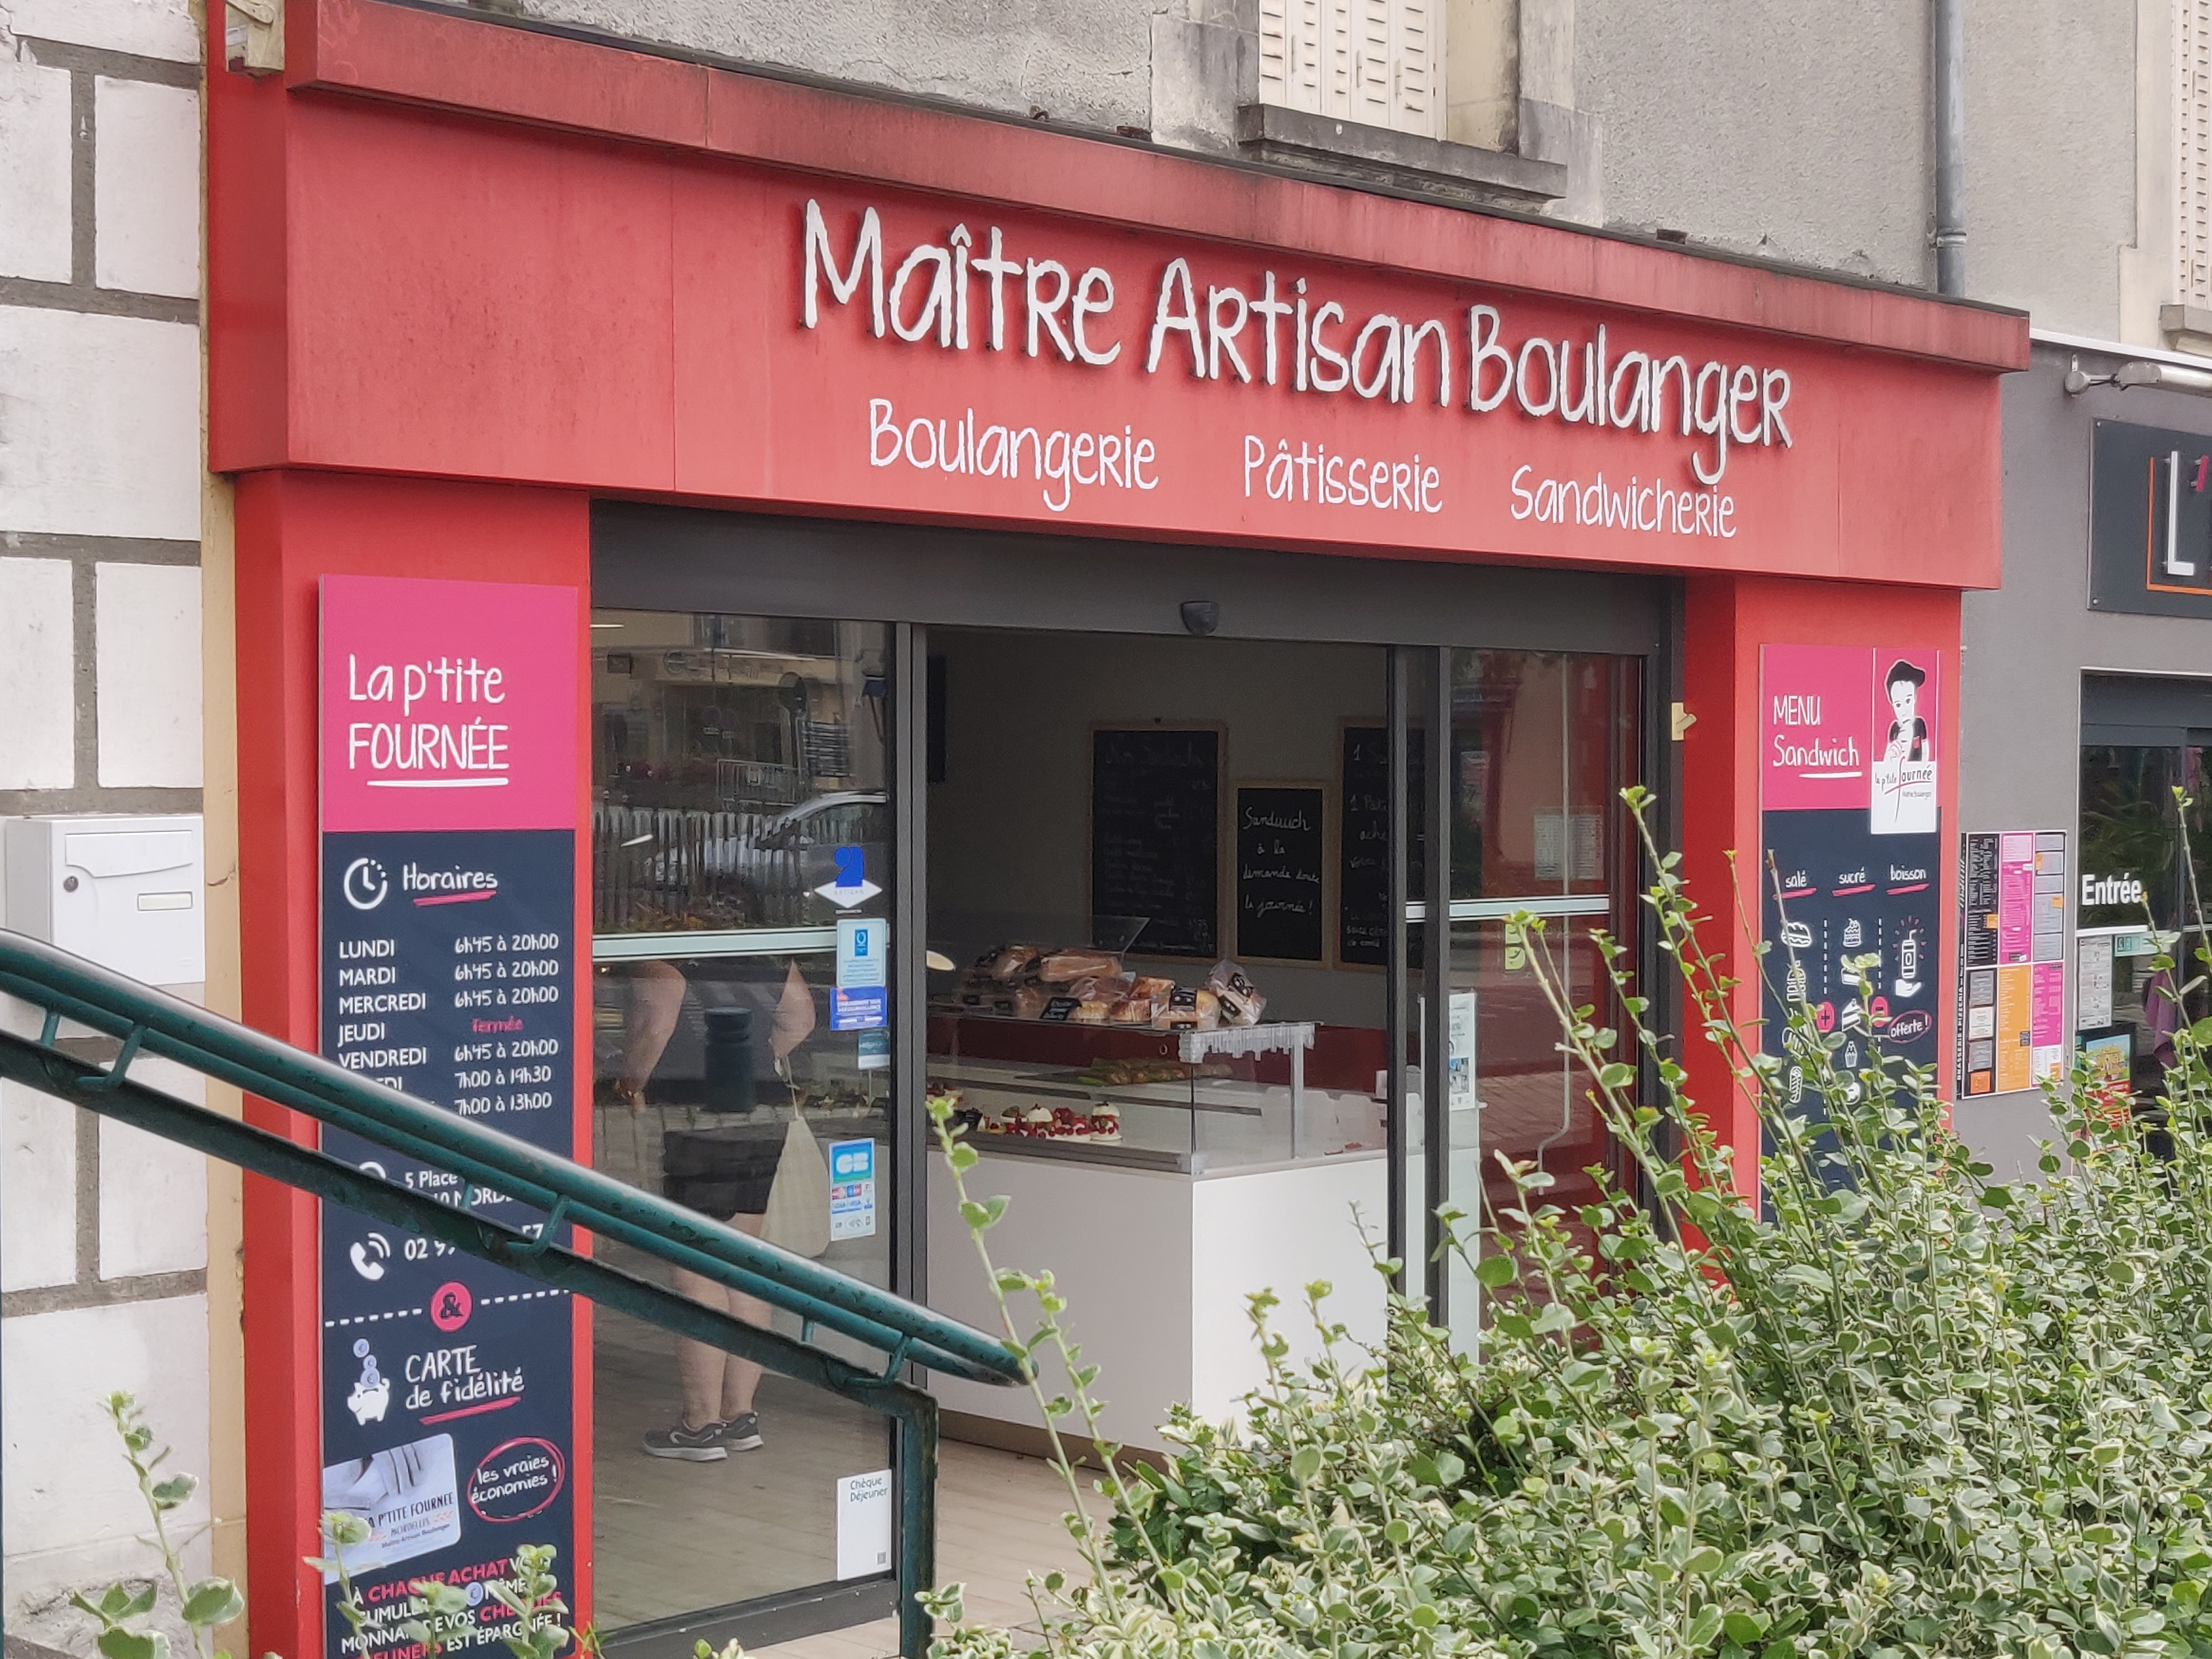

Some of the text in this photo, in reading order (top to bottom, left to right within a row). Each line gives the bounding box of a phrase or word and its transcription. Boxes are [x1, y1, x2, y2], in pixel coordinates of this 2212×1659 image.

[1148, 257, 1450, 408] Artisan
[1469, 303, 1793, 484] Boulanger
[869, 398, 1737, 538] Boulangerie Pâtisserie Sandwicherie
[349, 653, 505, 717] La p'tite
[1773, 694, 1821, 725] MENU
[349, 716, 510, 770] FOURNÉE
[1773, 734, 1860, 768] Sandwich
[403, 862, 499, 891] Horaires
[1785, 864, 1926, 888] salé sucré boisson
[2081, 873, 2142, 906] Entrée
[339, 933, 559, 959] LUNDI 6h45 à 20h00
[339, 959, 559, 987] MARDI 6h45 à 20h00
[339, 986, 559, 1015] MERCREDI 6h45 à 20h00
[337, 1022, 385, 1047] JEUDI
[1890, 1018, 1923, 1038] offerte
[338, 1038, 559, 1070] VENDREDI 6h45 à 20h00
[454, 1065, 552, 1089] 7h00 à 19h30
[454, 1092, 552, 1116] 7h00 à 13h00
[404, 1170, 458, 1189] 5 Place
[404, 1238, 429, 1262] 02
[405, 1344, 481, 1382] CARTE
[405, 1367, 525, 1410] de fidélité
[476, 1455, 550, 1485] les vraies
[850, 1478, 882, 1490] Chèque
[471, 1474, 549, 1504] économies
[851, 1488, 888, 1502] Déjeuner
[448, 1558, 509, 1586] ACHAT
[341, 1626, 410, 1655] MONNA
[445, 1609, 476, 1630] VOS
